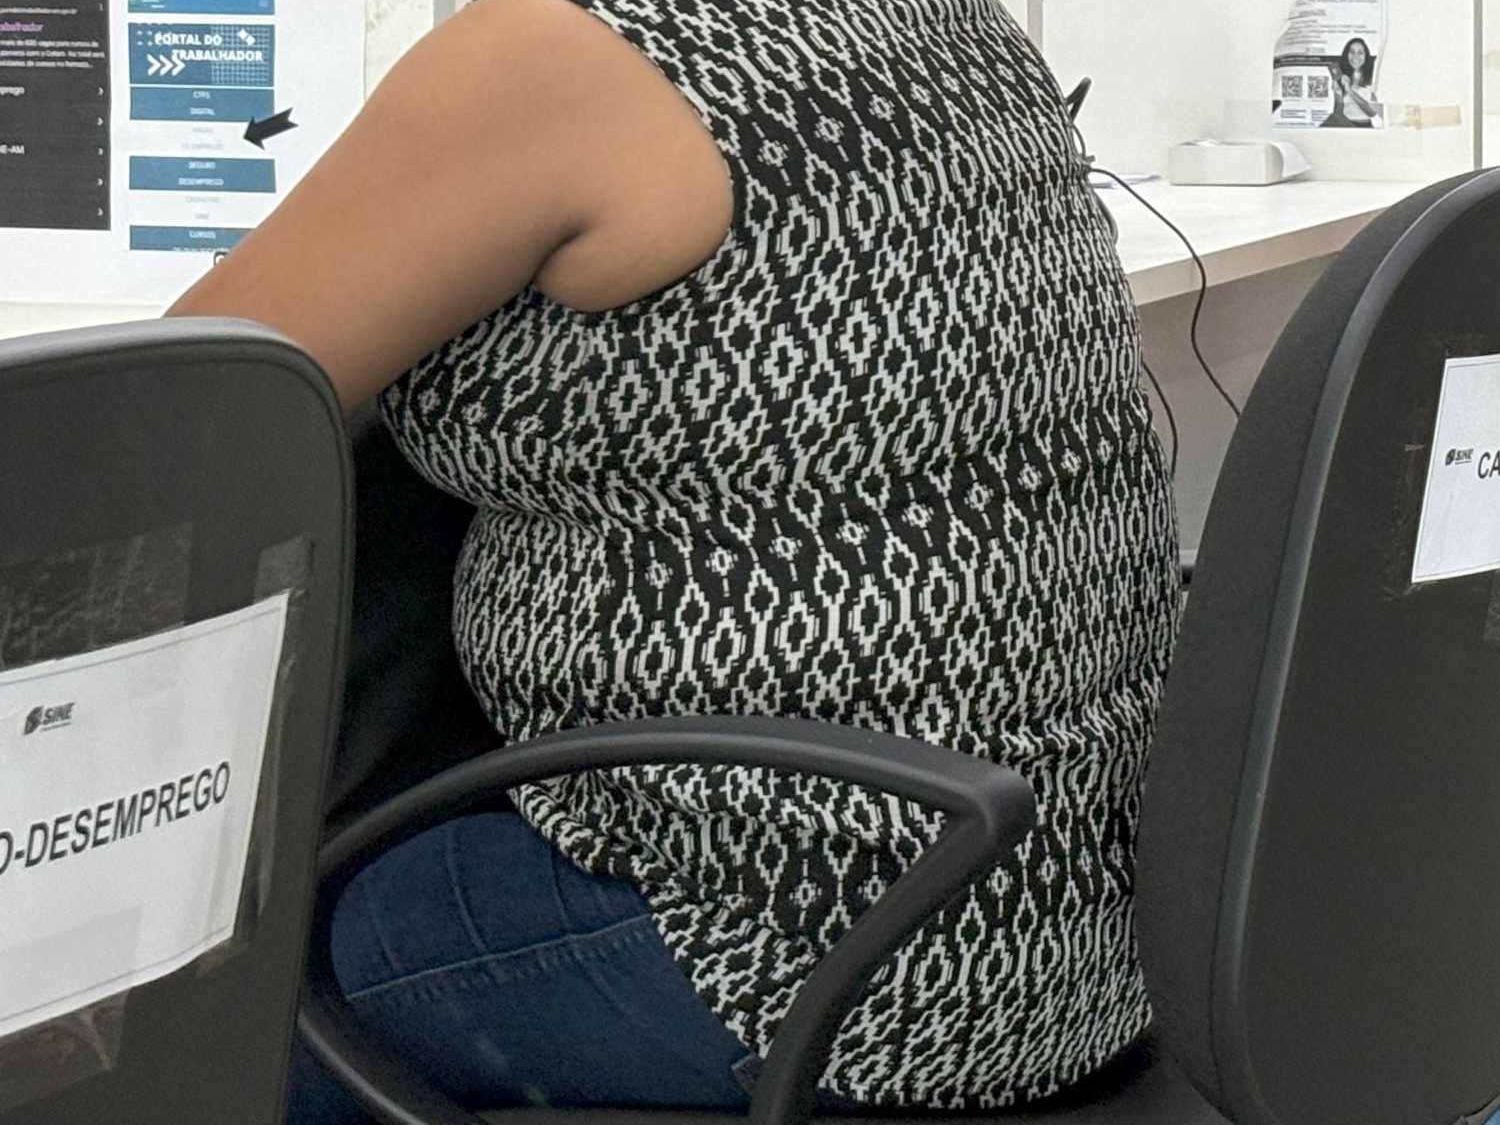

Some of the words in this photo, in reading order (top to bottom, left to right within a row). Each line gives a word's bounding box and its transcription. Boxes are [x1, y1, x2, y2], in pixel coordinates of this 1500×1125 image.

[154, 32, 201, 45] PORTAL
[204, 35, 223, 46] DO
[171, 49, 263, 61] TRABALHADOR
[43, 702, 74, 725] SINE
[0, 761, 230, 875] O-DESEMPREGO
